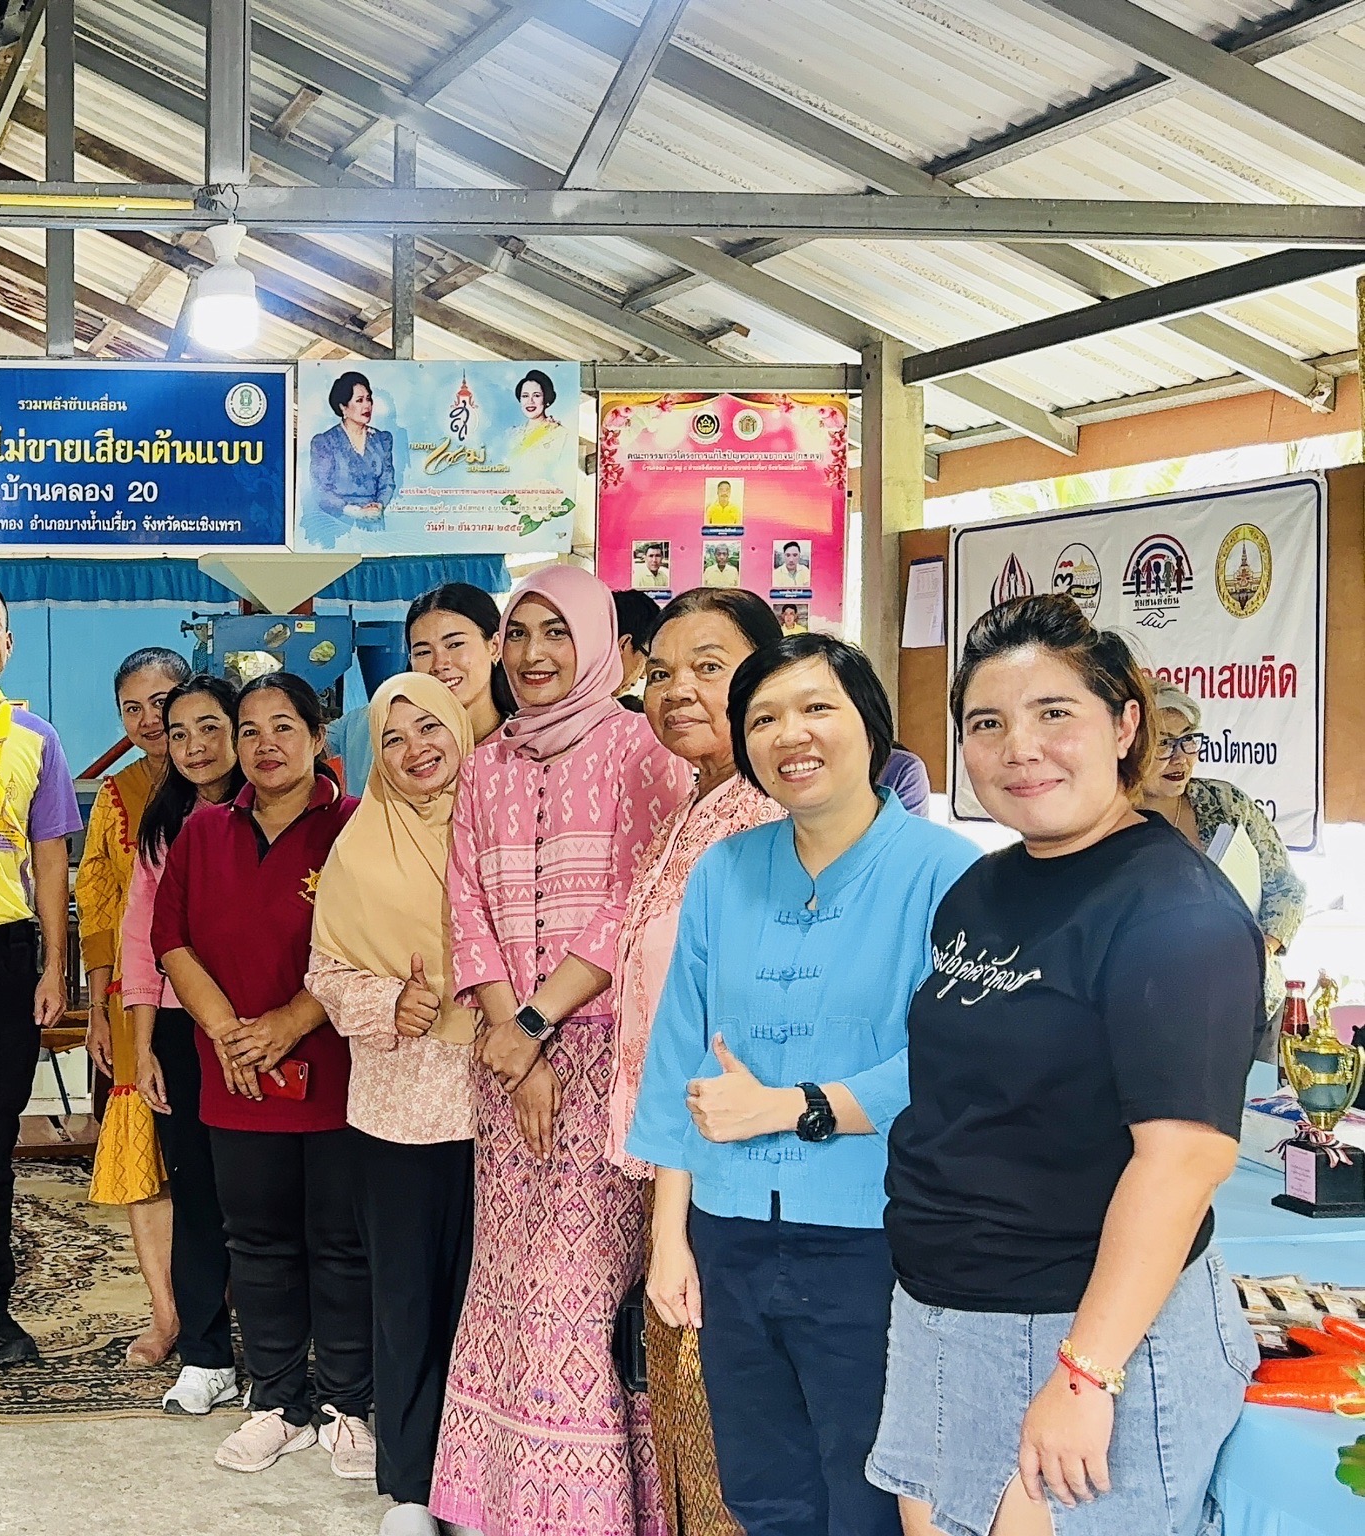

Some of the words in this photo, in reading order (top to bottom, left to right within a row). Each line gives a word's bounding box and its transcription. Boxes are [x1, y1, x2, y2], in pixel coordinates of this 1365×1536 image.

[18, 393, 128, 412] รวมพลังขับเคลื่อน
[0, 473, 114, 502] บ้านคลอง
[128, 481, 159, 502] 20
[30, 510, 137, 531] อำเภอบางน้ำเปรี้ยว
[142, 515, 242, 532] จังหวัดฉะเชิงเทรา
